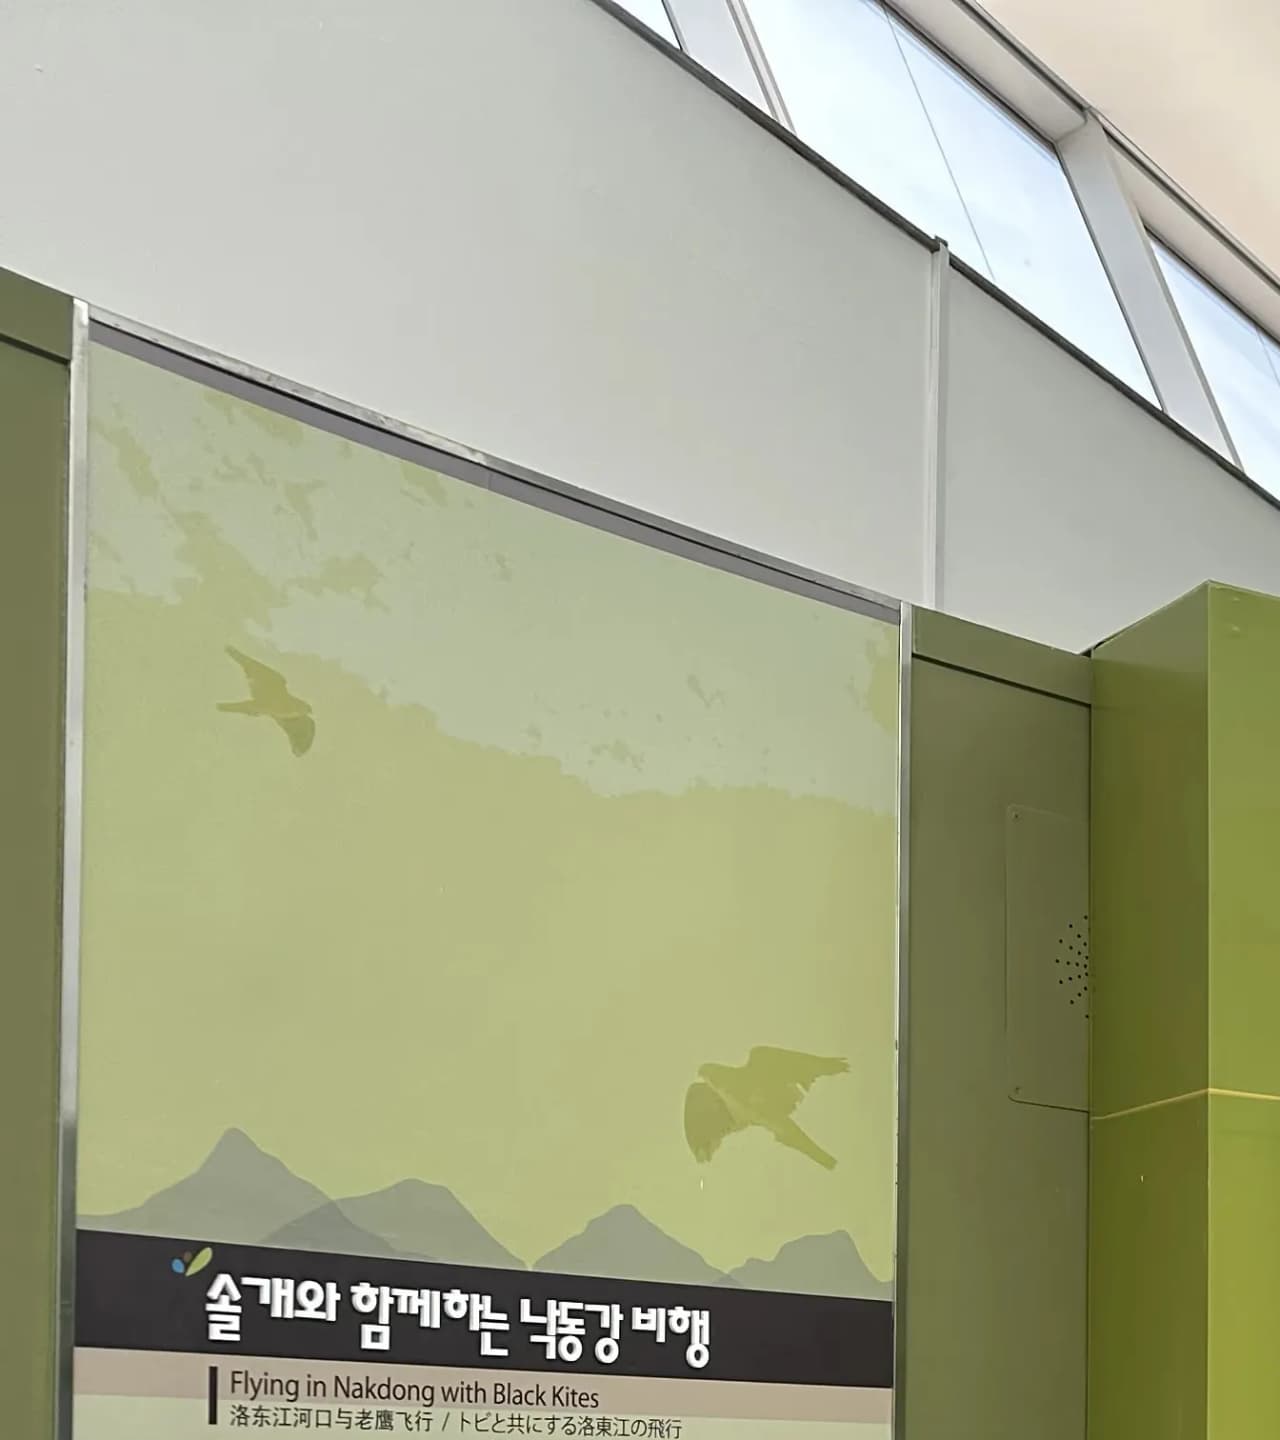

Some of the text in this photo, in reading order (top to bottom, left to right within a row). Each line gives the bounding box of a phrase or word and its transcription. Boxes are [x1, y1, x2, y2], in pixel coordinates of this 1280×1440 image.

[206, 1274, 709, 1368] 솔개와 함께하는 낙동강 비행
[231, 1370, 598, 1408] Flying in Nakdong with Black Kites
[231, 1401, 434, 1432] 洛东江河口与老鹰飞行
